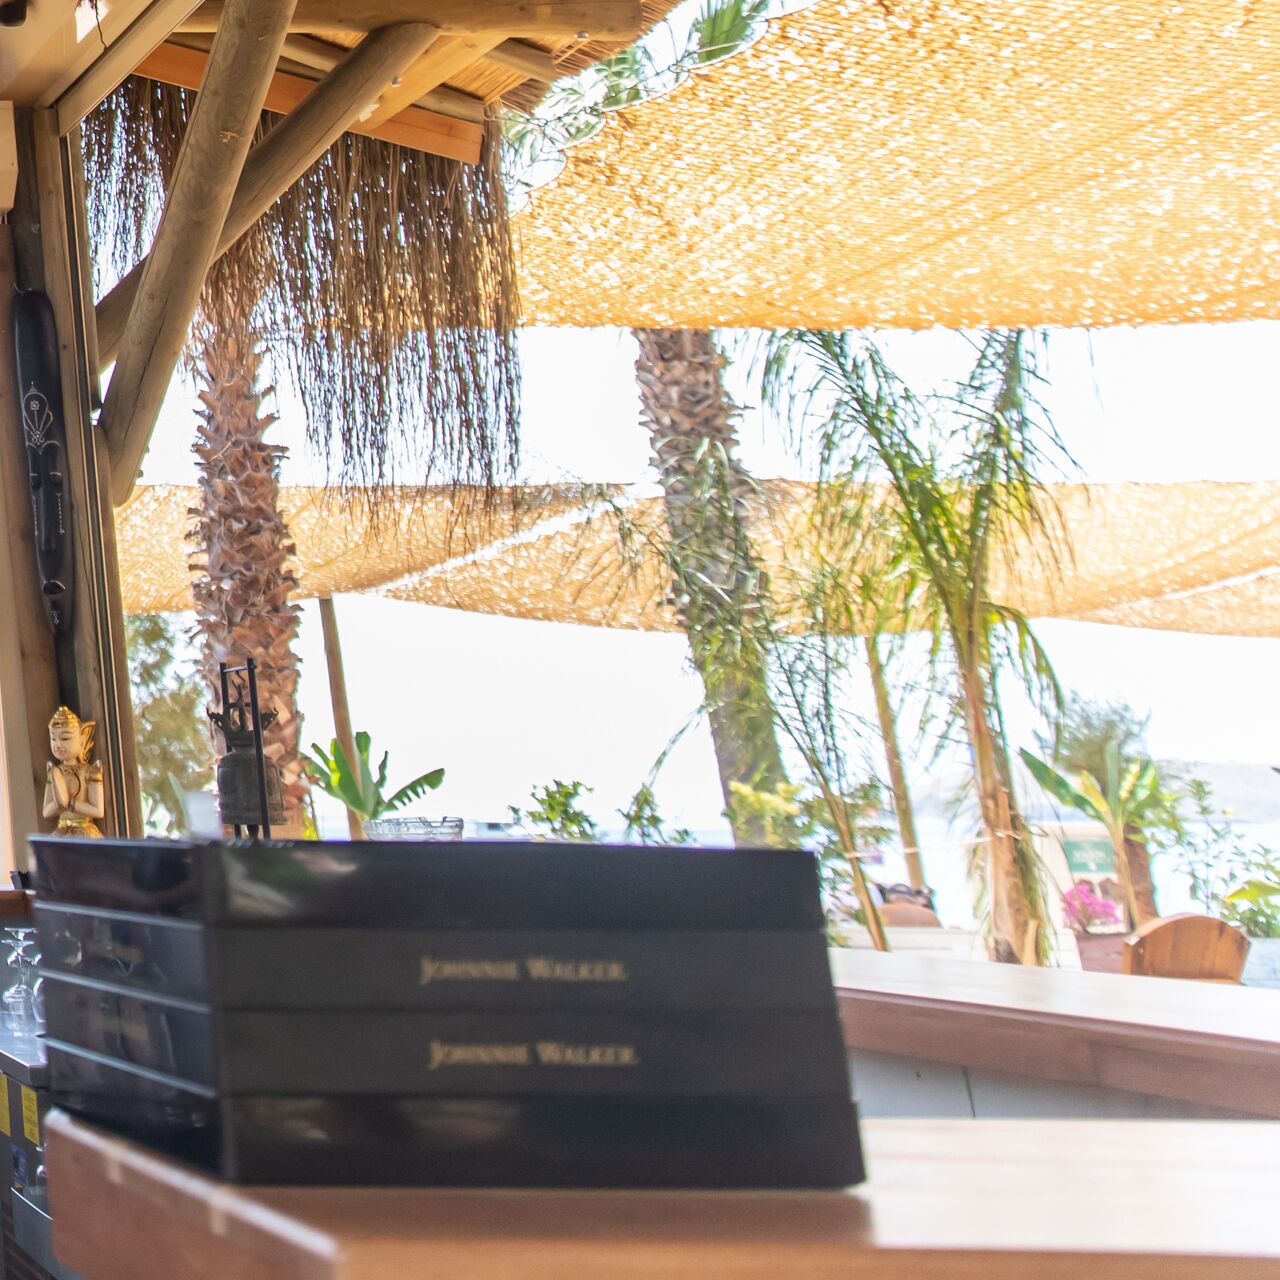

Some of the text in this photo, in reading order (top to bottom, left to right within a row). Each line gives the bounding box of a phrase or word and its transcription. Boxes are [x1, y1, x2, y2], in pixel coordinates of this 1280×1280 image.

[419, 957, 626, 986] JOHNNIE WALKER
[427, 1040, 638, 1071] JOHNNIE WALKER
